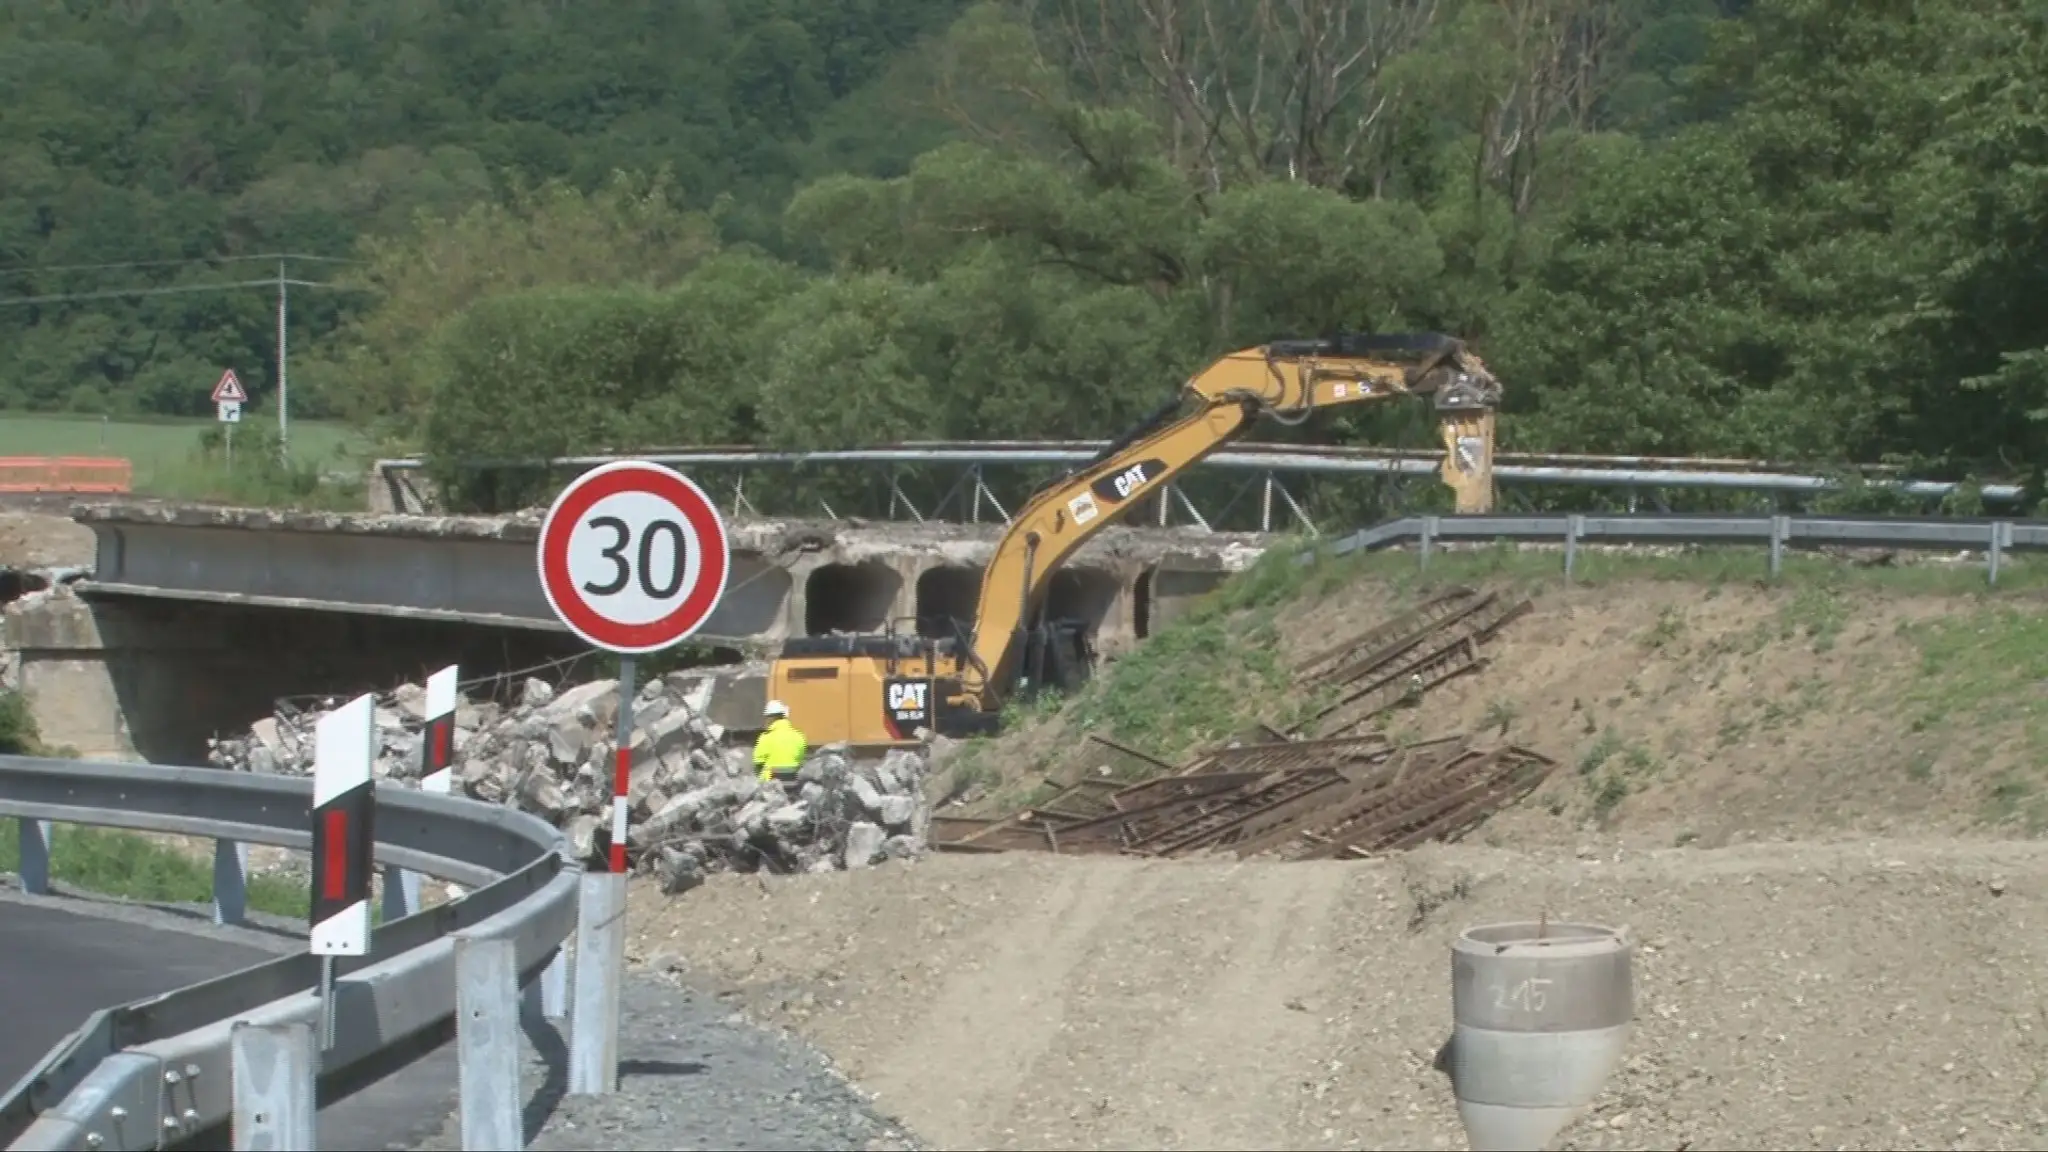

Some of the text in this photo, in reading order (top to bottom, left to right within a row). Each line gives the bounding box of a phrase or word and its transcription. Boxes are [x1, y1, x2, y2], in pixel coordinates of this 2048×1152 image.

[1114, 464, 1147, 497] CAT
[584, 516, 686, 600] 30
[889, 683, 927, 709] CAT
